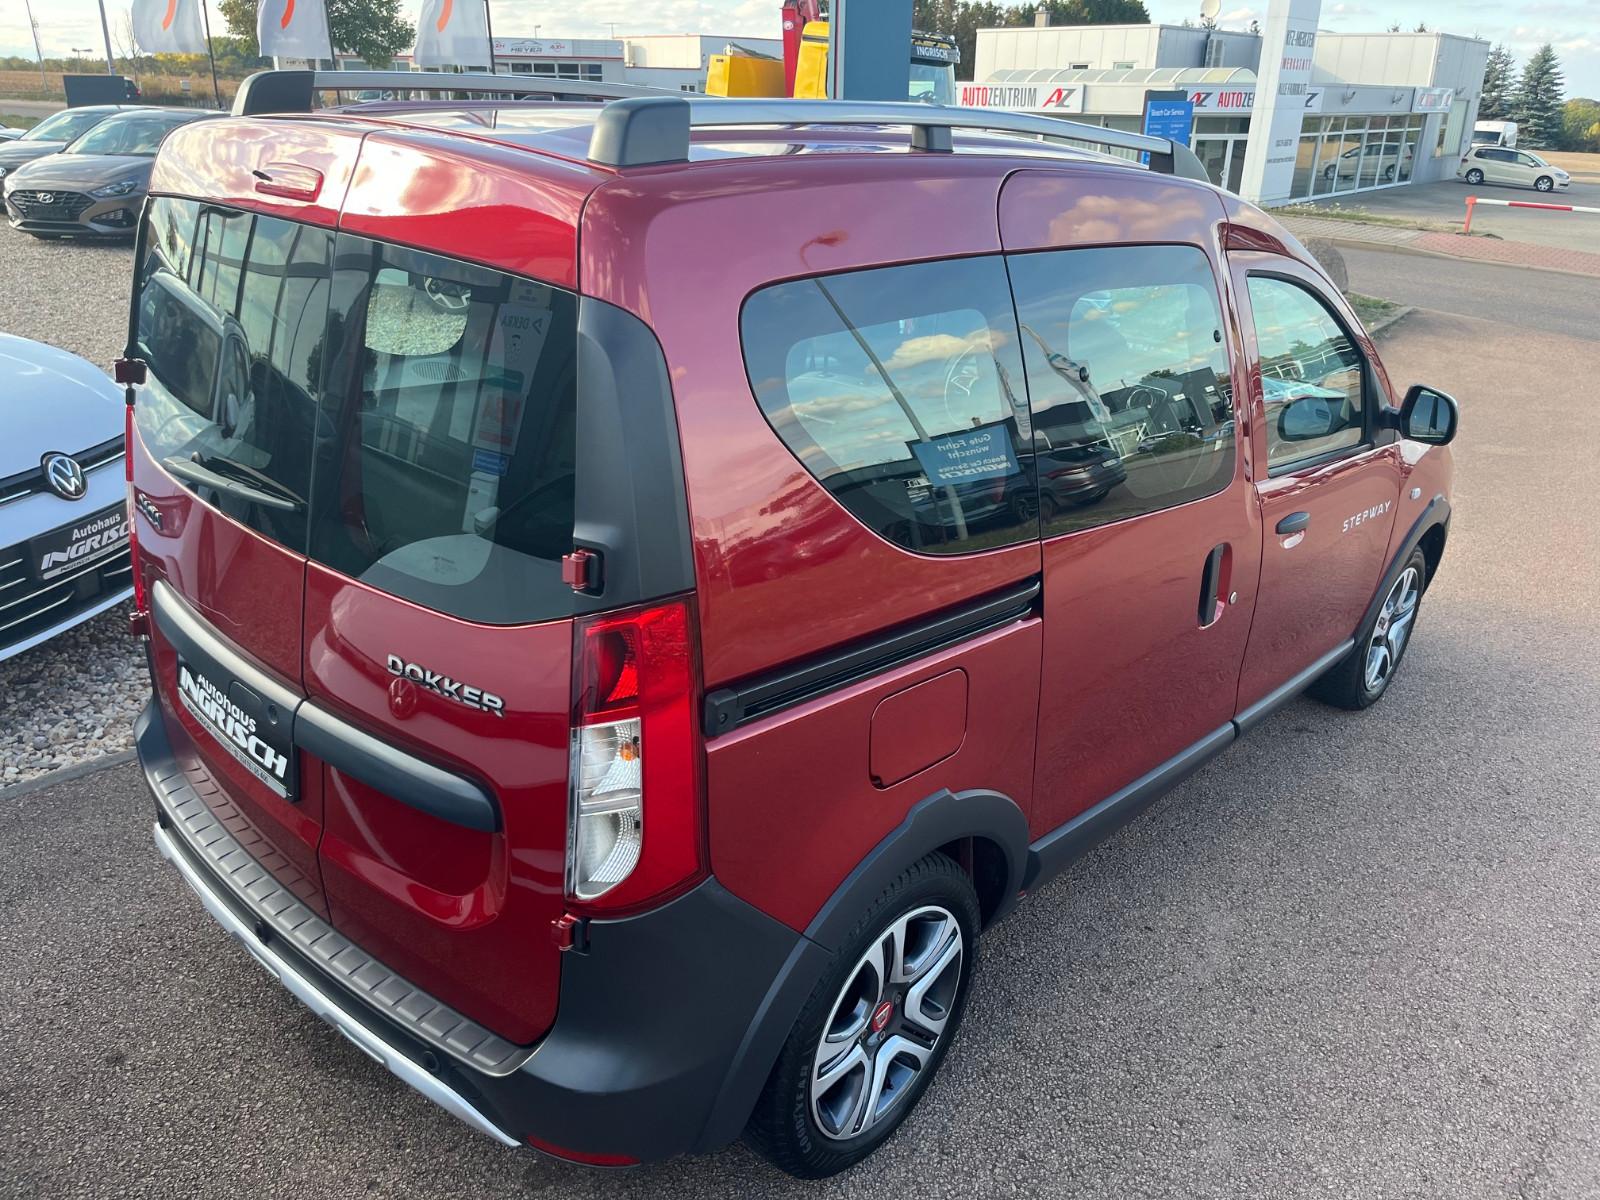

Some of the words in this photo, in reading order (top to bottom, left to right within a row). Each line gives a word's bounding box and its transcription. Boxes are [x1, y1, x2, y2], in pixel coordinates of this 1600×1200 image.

[916, 46, 948, 59] INGRISCH
[961, 87, 1037, 107] AUTOZENTRUM
[72, 513, 121, 541] Autohaus
[1342, 499, 1391, 533] STEPWAY
[41, 520, 131, 571] INGRISC
[197, 674, 257, 732] Autohaus
[387, 653, 505, 718] DOKKER
[180, 666, 288, 779] INGRISCH
